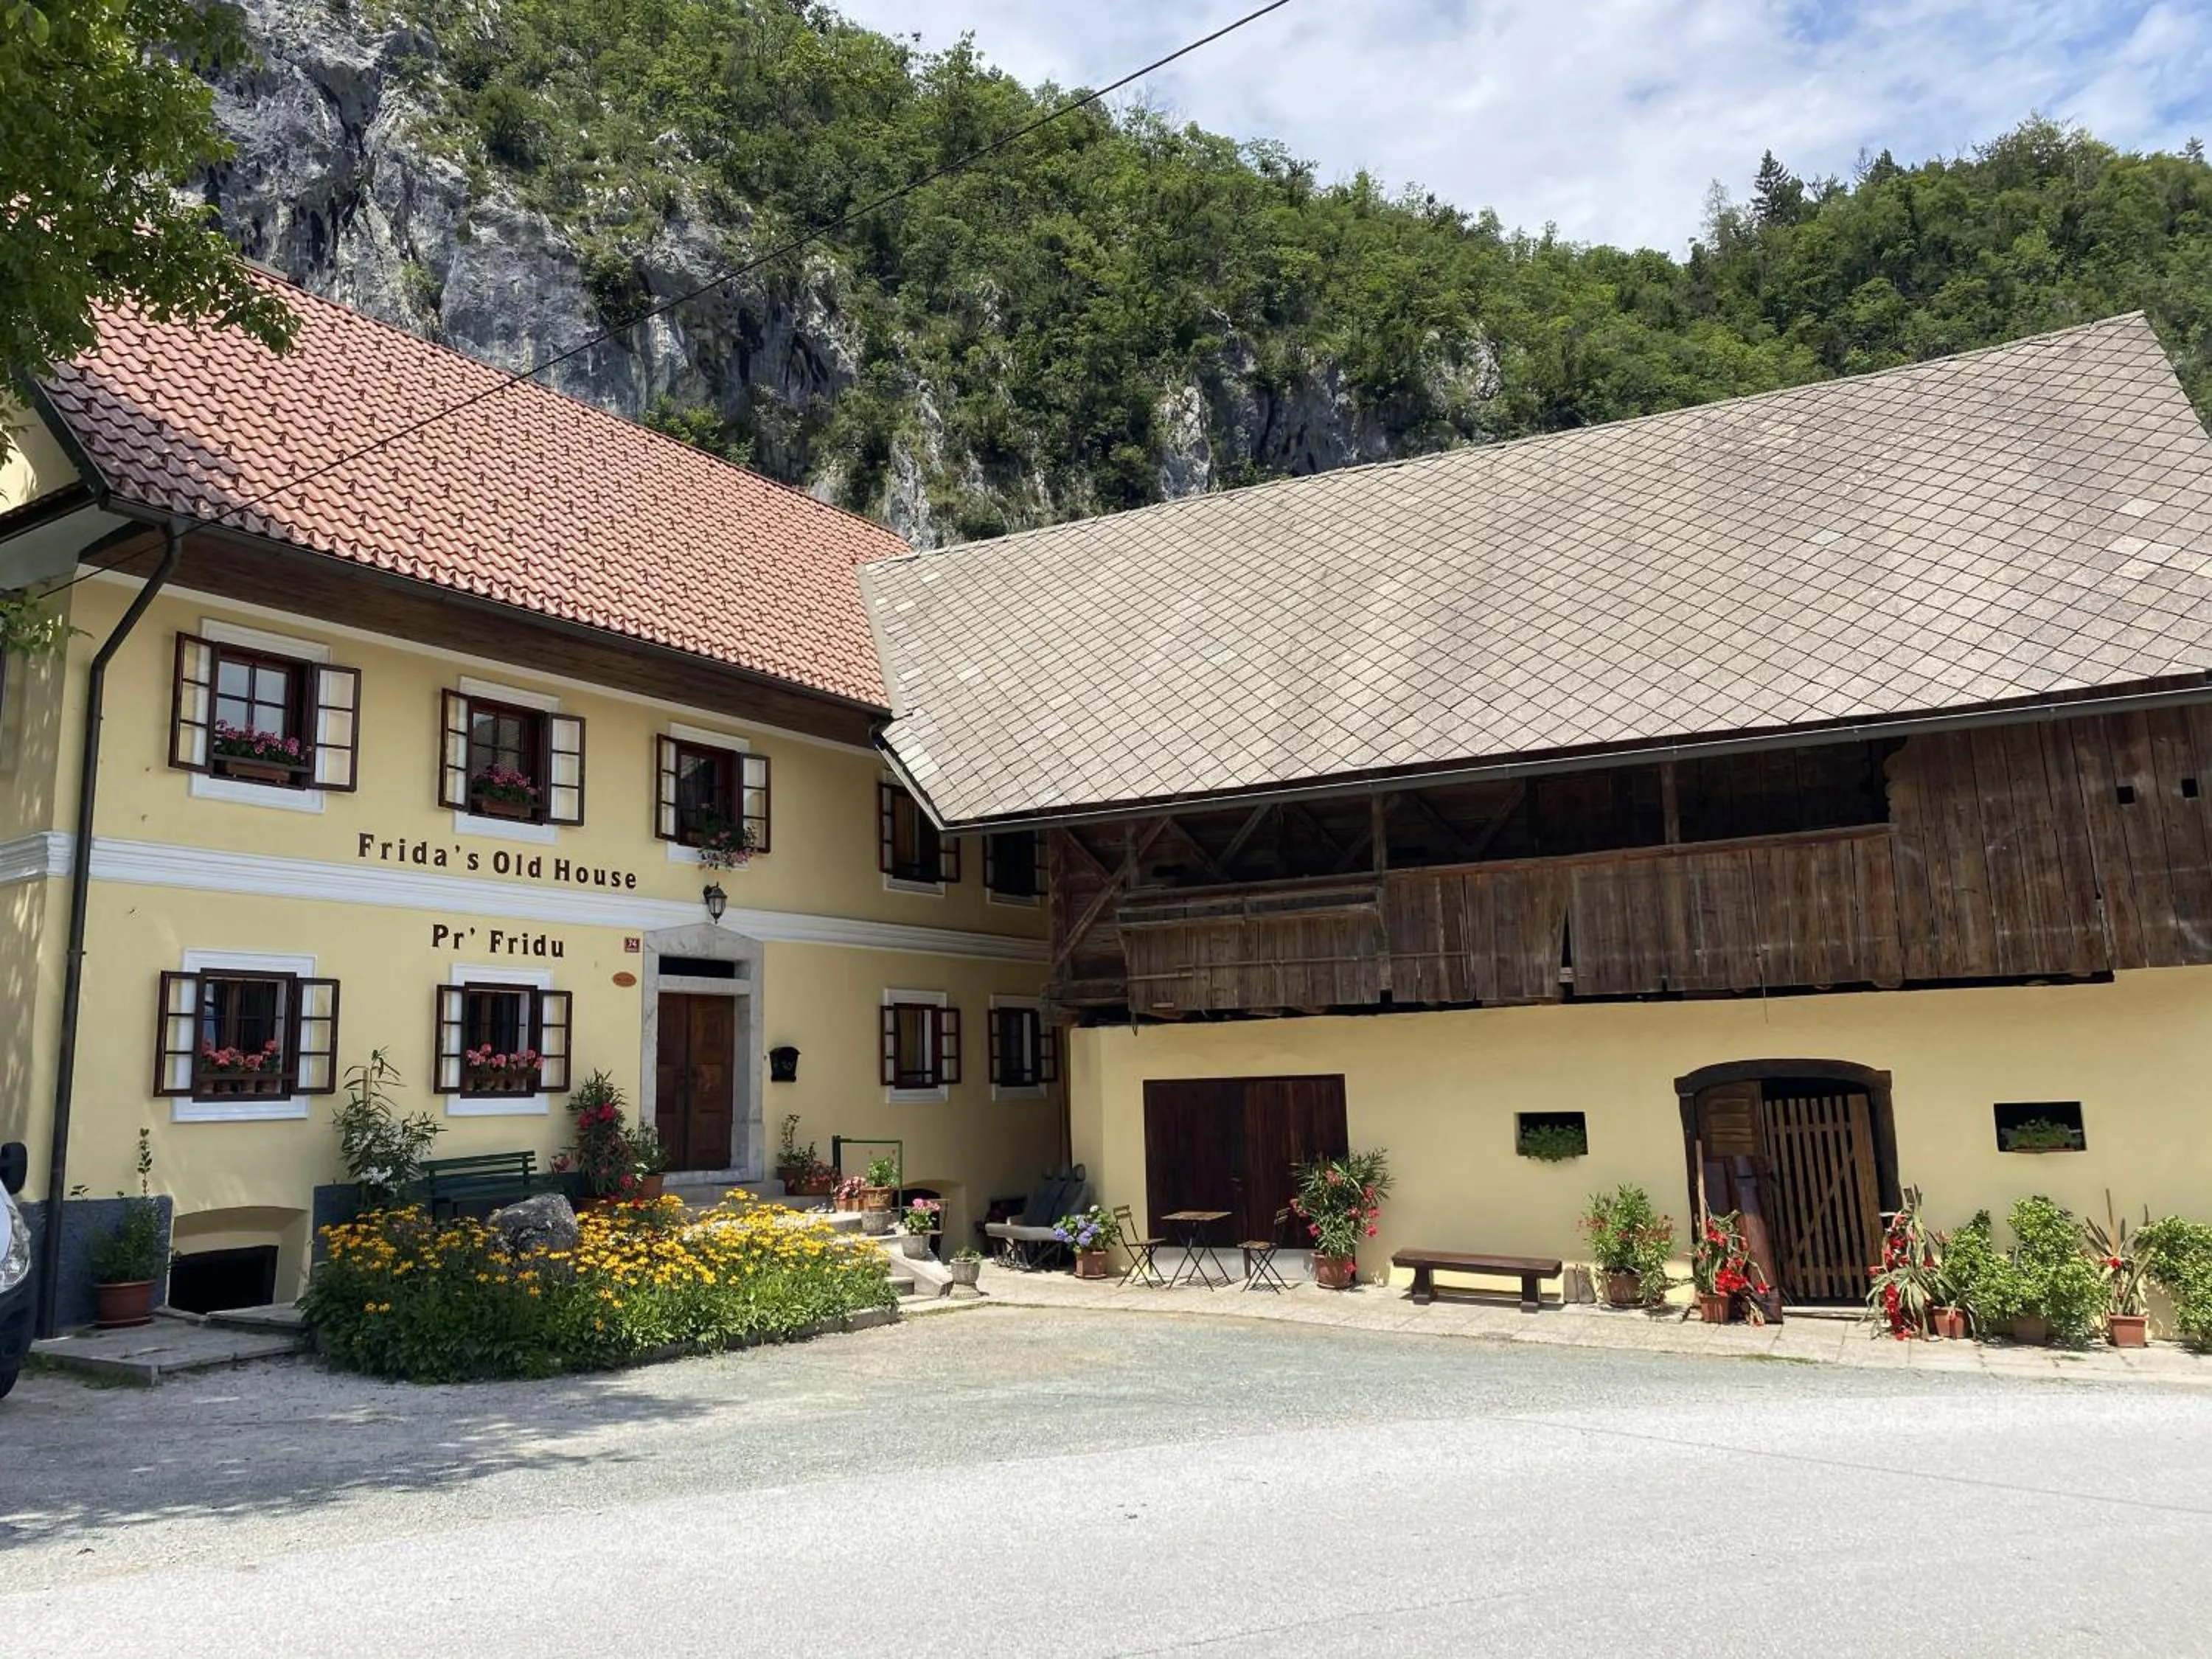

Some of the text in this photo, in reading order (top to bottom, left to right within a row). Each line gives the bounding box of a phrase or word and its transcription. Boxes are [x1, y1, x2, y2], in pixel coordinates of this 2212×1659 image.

[358, 833, 636, 888] Frida's Old House
[431, 924, 564, 958] Pr' Fridu
